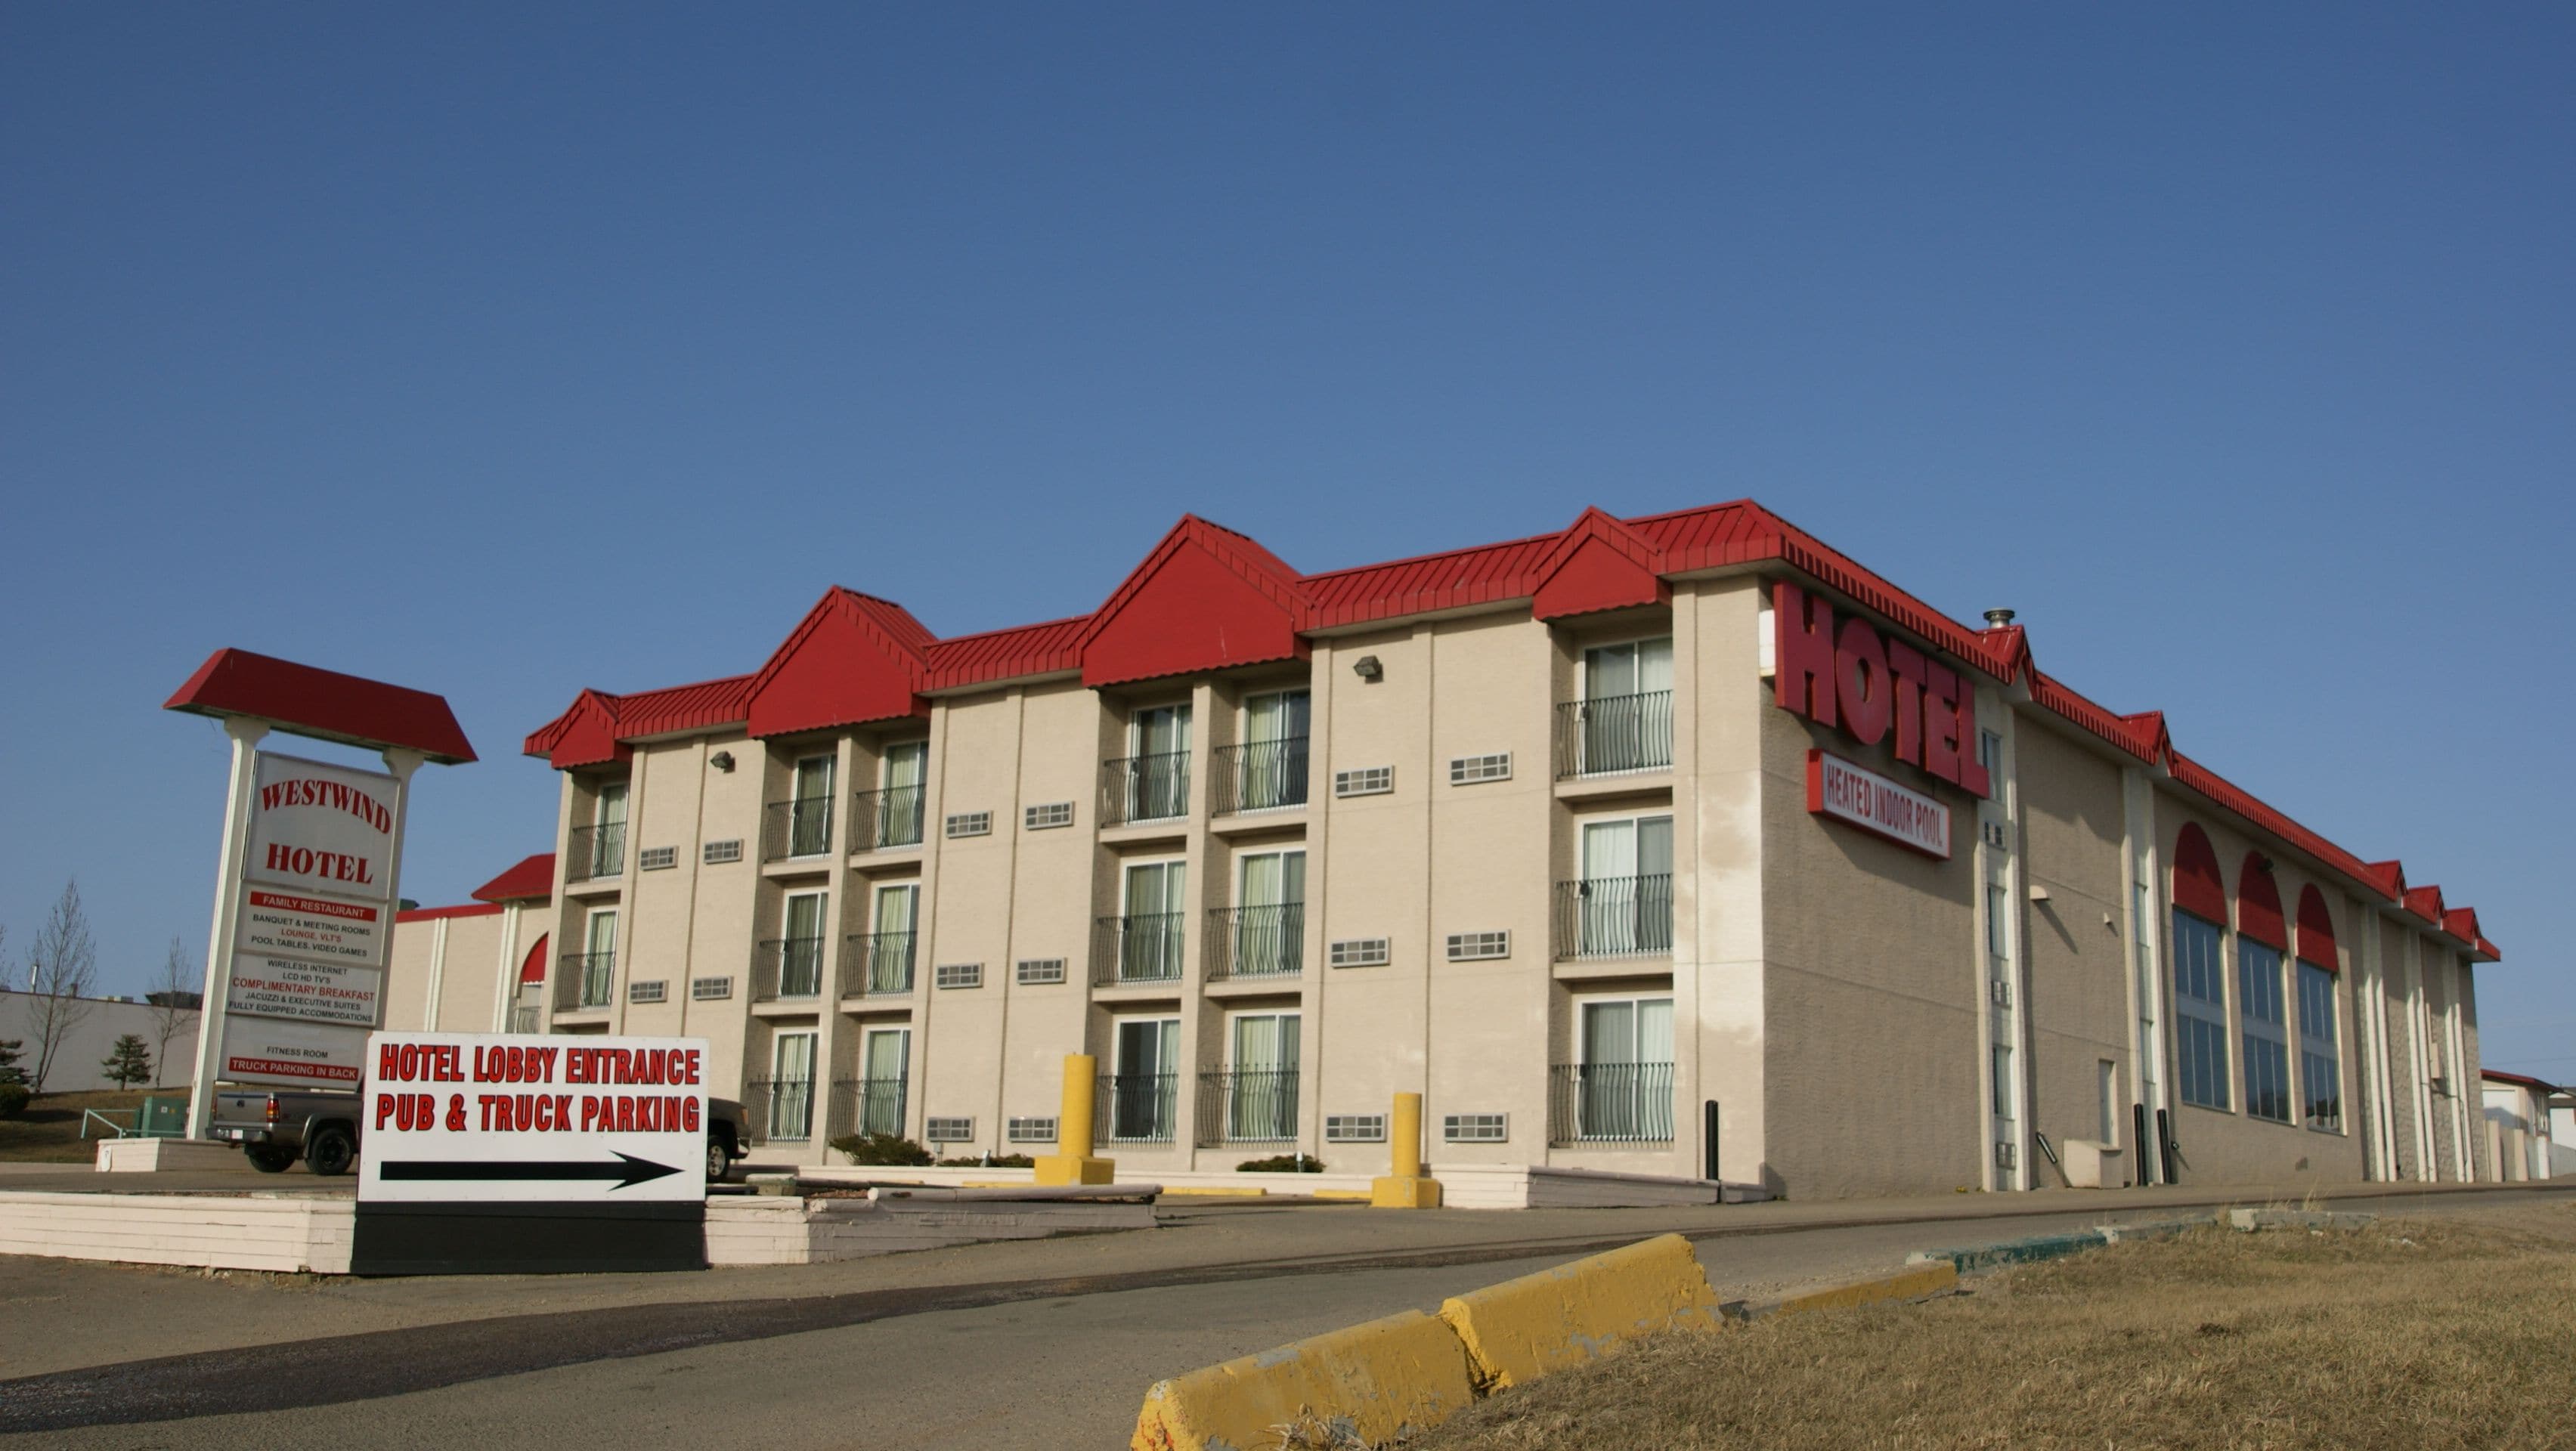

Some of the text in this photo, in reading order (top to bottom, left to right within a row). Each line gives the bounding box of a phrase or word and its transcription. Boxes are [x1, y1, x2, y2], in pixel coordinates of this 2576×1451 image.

[1773, 580, 1989, 800] HOTEL
[262, 779, 391, 834] WESTWIND
[1827, 763, 1943, 847] HEATED INDOOR POOL
[266, 843, 373, 885] HOTEL
[263, 896, 365, 917] FAMILY RESTAURANT
[253, 914, 293, 926] BANQUET
[303, 920, 339, 932] MEETING
[342, 926, 370, 936] ROOMS
[281, 929, 342, 943] LOUNGE, VLT'S
[251, 935, 274, 945] POOL
[312, 943, 337, 953] VIDEO
[339, 946, 367, 957] GAMES
[268, 959, 347, 975] WIRELESS INTERNET
[233, 977, 375, 1001] COMPLIMENTARY BREAKFAST
[283, 973, 330, 984] LCD HD TV'S
[229, 1001, 372, 1022] FULLY EQUIPPED ACCOMMODATIONS
[246, 992, 279, 1001] JACUZZI
[289, 996, 332, 1007] EXECUTIVE
[334, 1001, 361, 1010] SUITES
[267, 1046, 328, 1058] FITNESS ROOM
[233, 1060, 357, 1079] TRUCK PARKING IN BACK
[379, 1044, 700, 1084] HOTEL LOBBY ENTRANCE
[376, 1094, 700, 1132] PUB & TRUCK PARKING
